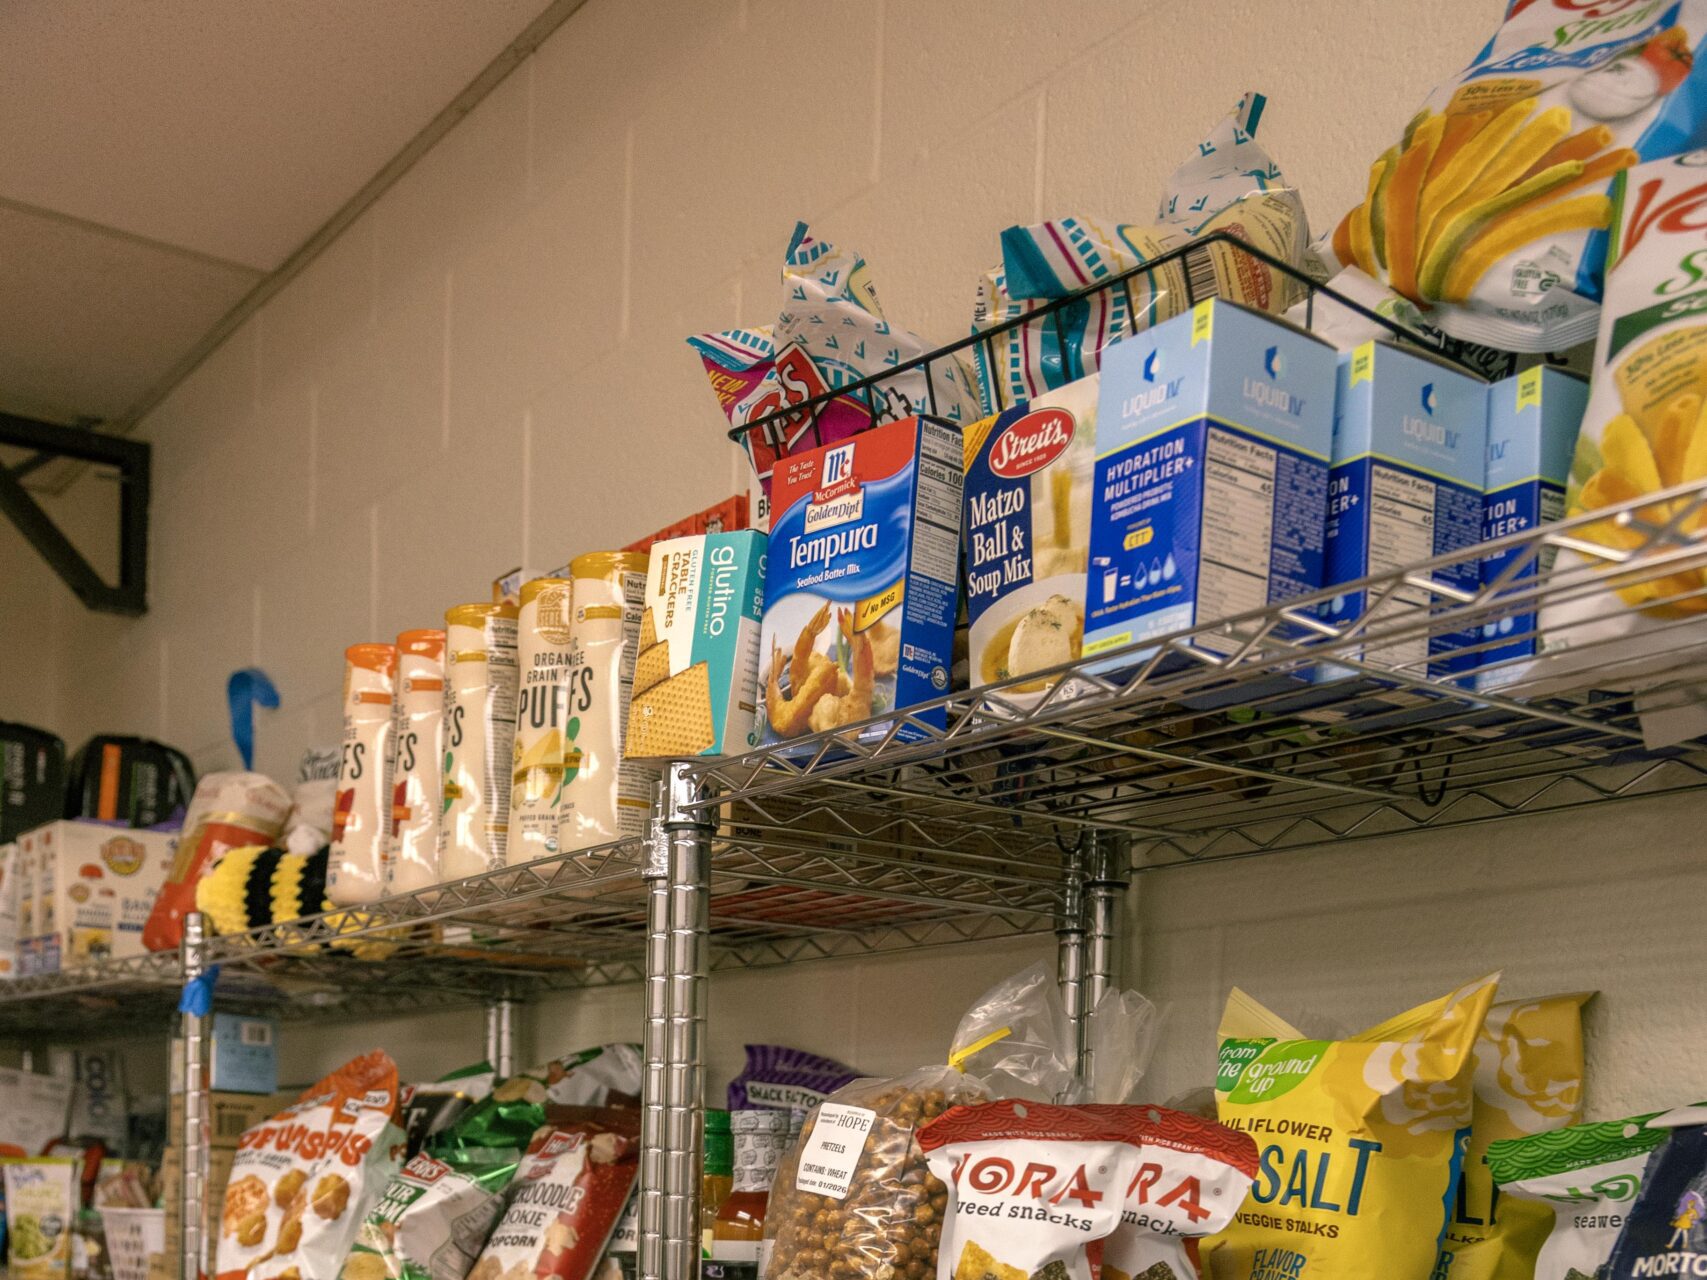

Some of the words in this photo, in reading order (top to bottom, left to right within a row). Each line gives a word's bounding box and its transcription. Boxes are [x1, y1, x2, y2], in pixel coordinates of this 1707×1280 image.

[708, 370, 748, 393] NEW
[923, 423, 949, 443] Nutrition
[993, 417, 1068, 470] Streit's
[1107, 437, 1184, 482] HYDRATION
[921, 464, 945, 481] Calories
[948, 470, 964, 487] 100
[815, 479, 856, 502] McCormick
[970, 487, 1025, 530] Matzo
[789, 523, 879, 569] Tempura
[973, 521, 1008, 567] Ball
[1011, 525, 1024, 550] &
[678, 549, 691, 595] TABLE
[690, 549, 698, 582] GLUTEN
[796, 570, 824, 589] Seafood
[824, 565, 846, 581] Batter
[846, 563, 861, 574] Mix
[969, 571, 1000, 597] Soup
[1004, 557, 1032, 582] Mix
[664, 551, 681, 630] CRACKERS
[685, 584, 695, 612] FREE
[710, 545, 738, 638] glutino
[869, 603, 882, 615] No
[881, 592, 896, 609] MSG
[1219, 1046, 1256, 1061] from
[1247, 1054, 1318, 1083] ground
[749, 1086, 781, 1103] SNACK
[1250, 1078, 1275, 1098] up
[837, 1114, 870, 1132] HOPE
[820, 1141, 846, 1153] PRETZELS
[803, 1162, 826, 1175] CONTAINS:
[827, 1168, 848, 1180] WHEAT
[1251, 1138, 1383, 1216] SALT
[818, 1180, 847, 1194] 01/2026
[1007, 1200, 1093, 1233] snacks
[1235, 1212, 1283, 1231] VEGGIE
[1286, 1219, 1340, 1239] STALKS
[1253, 1247, 1306, 1278] FLAVOR
